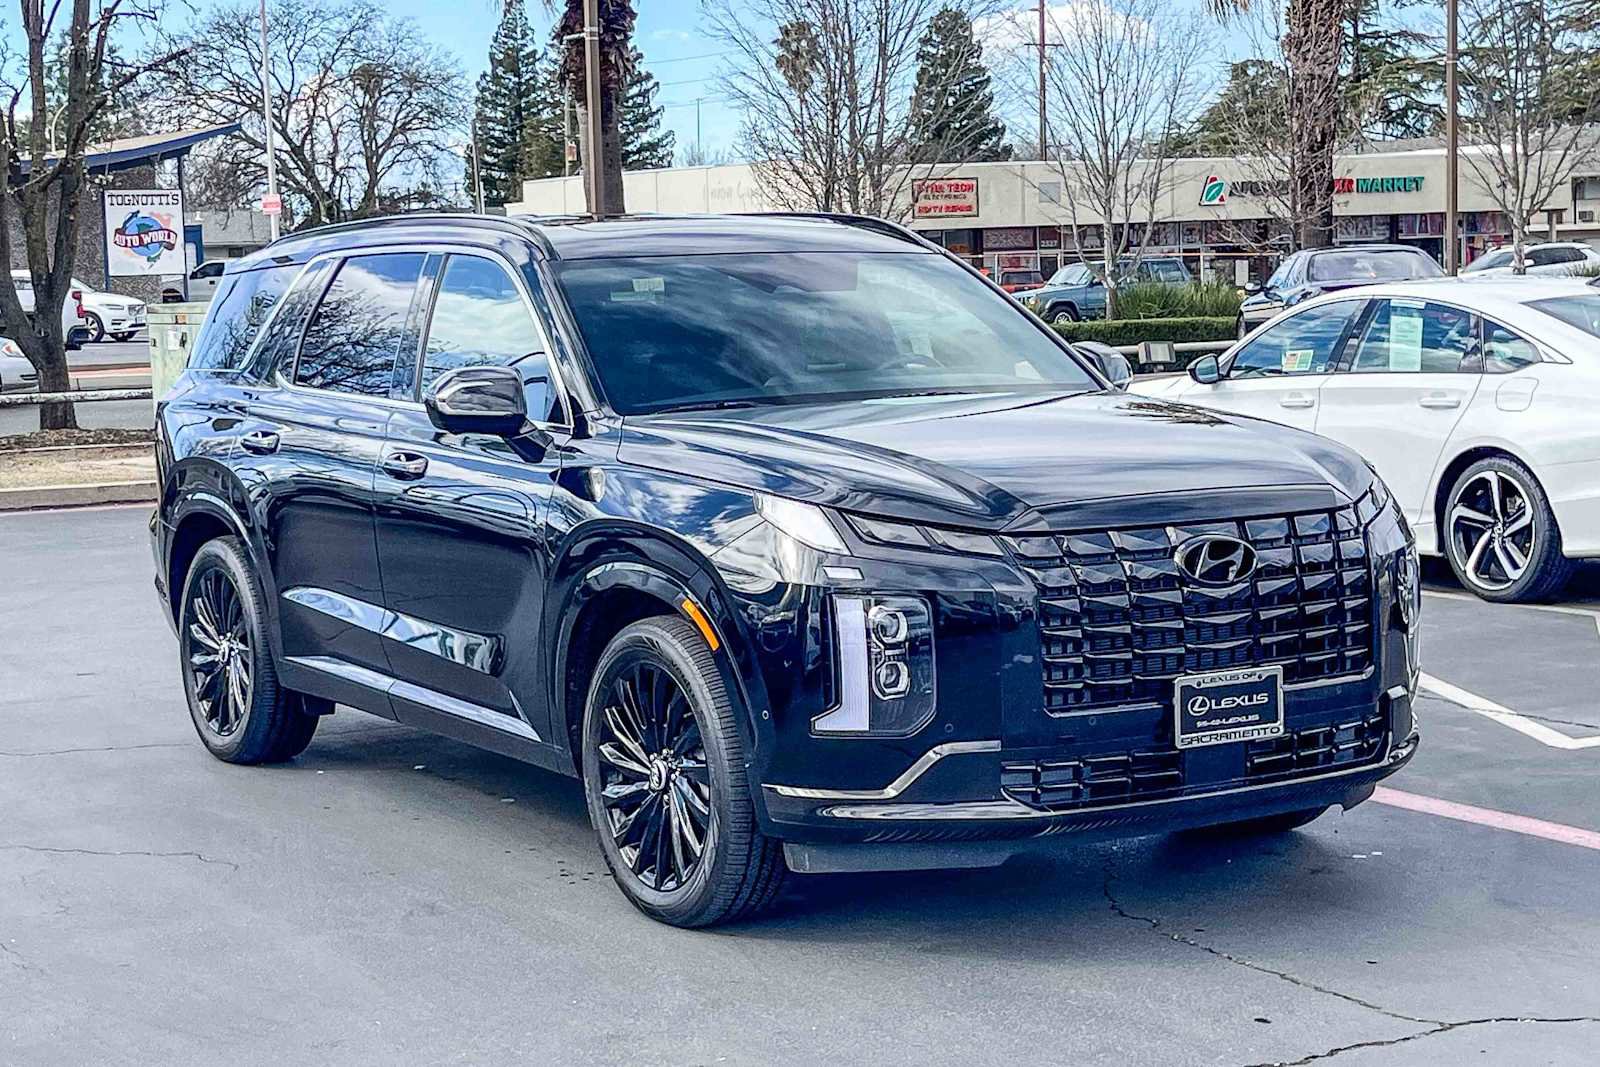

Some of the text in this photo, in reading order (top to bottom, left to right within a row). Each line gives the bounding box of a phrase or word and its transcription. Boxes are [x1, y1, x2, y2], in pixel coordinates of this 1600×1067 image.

[1356, 176, 1425, 193] MARKET
[108, 194, 180, 206] TOGNOTTI'S
[114, 230, 176, 247] AUTO WORLD
[1202, 674, 1240, 684] LEXUS
[1211, 693, 1269, 710] LEXUS
[1180, 726, 1281, 745] SACRAMENTO
